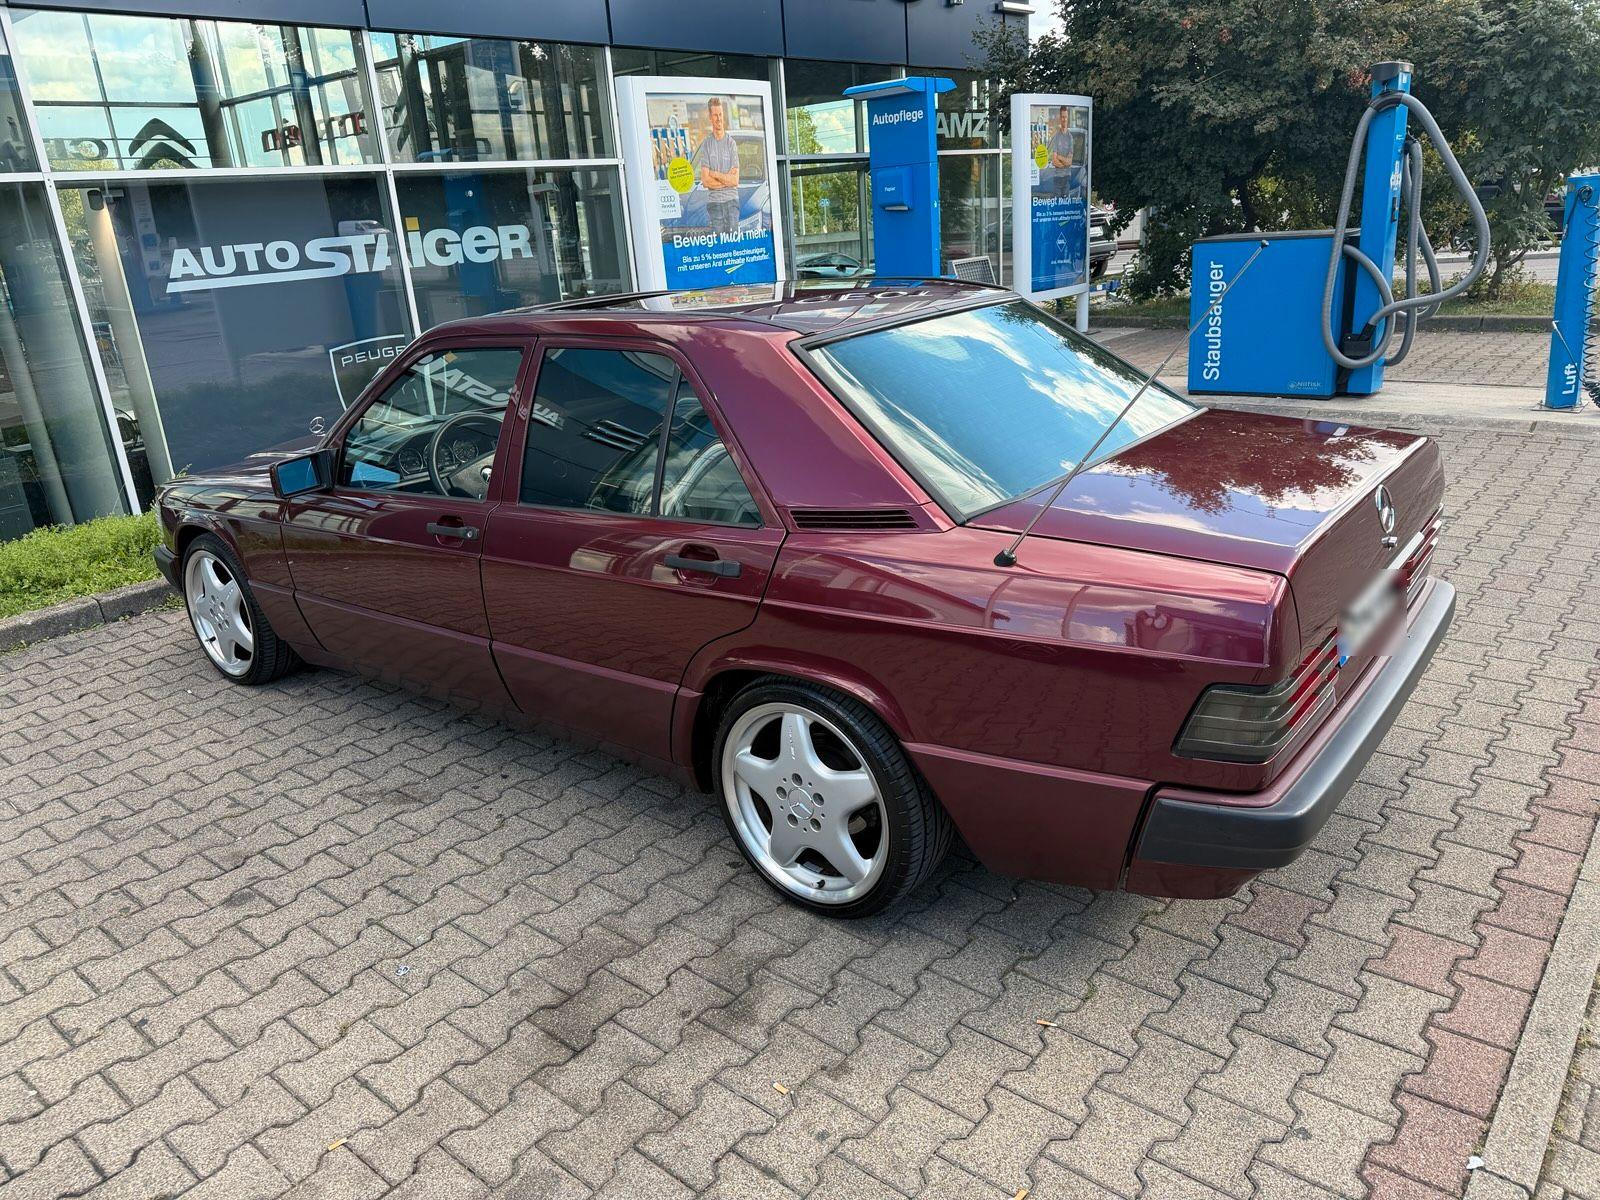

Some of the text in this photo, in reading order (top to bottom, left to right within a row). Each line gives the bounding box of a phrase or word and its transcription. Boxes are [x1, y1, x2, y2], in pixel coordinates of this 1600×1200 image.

[872, 109, 924, 126] Autopflege
[1032, 196, 1058, 207] Bewegt
[673, 225, 768, 249] Bewegt mich mehr.
[677, 264, 688, 273] mit
[1203, 261, 1227, 380] Staubsauger
[1562, 363, 1578, 395] Luft
